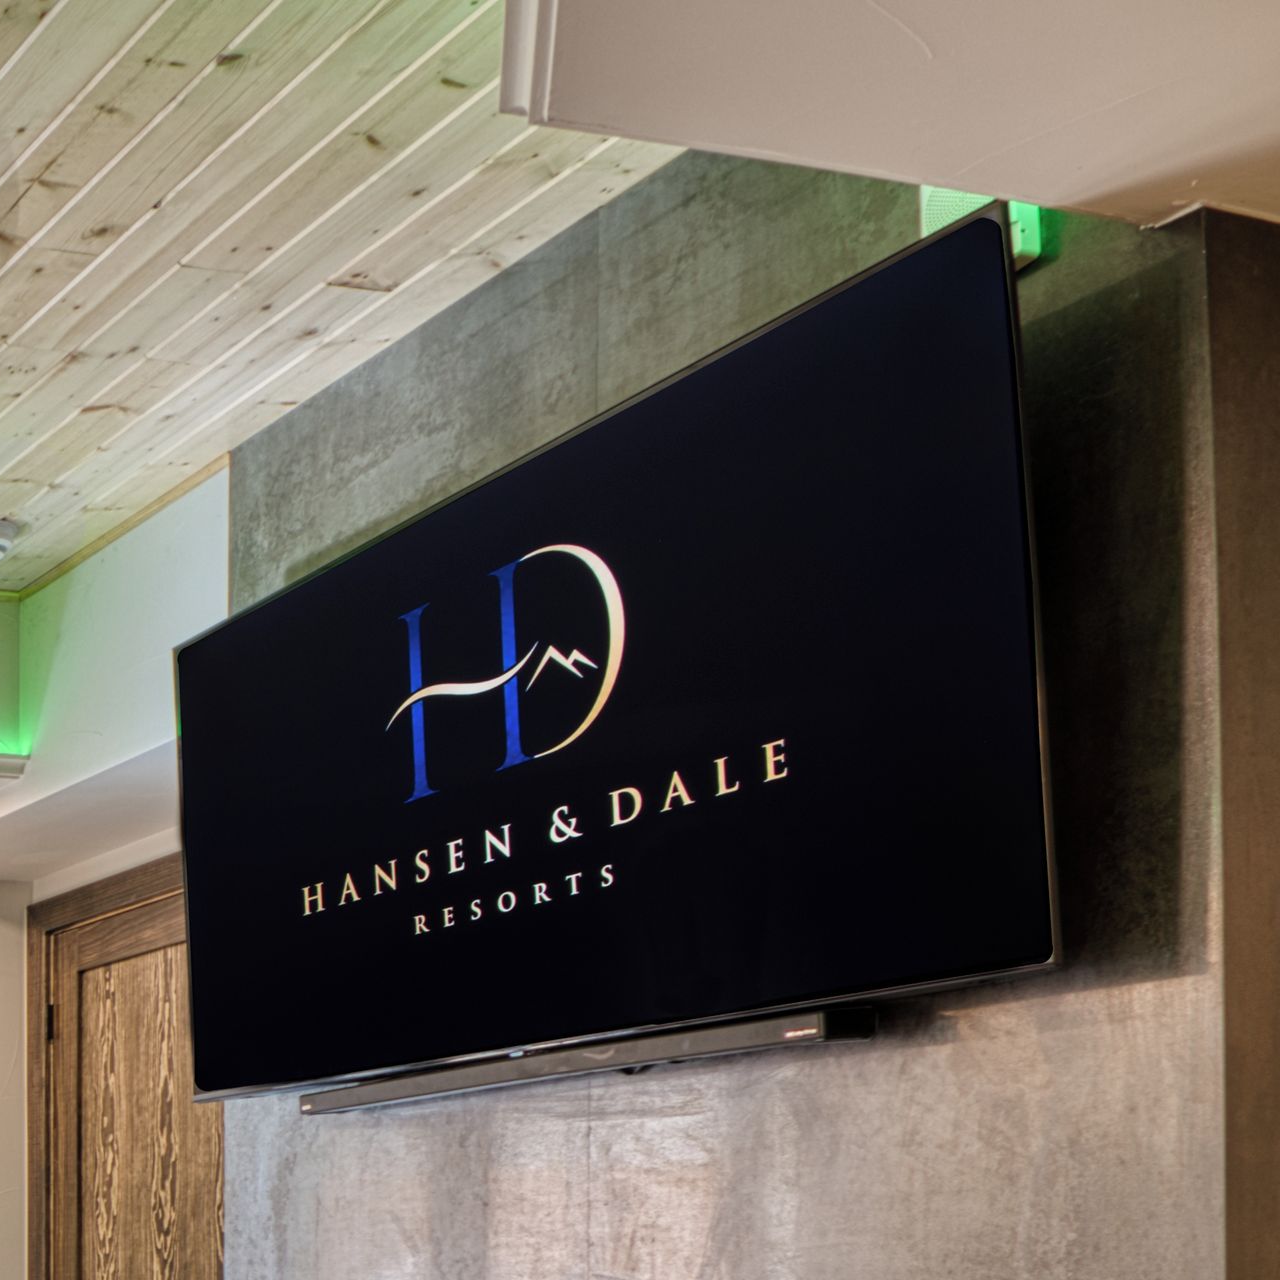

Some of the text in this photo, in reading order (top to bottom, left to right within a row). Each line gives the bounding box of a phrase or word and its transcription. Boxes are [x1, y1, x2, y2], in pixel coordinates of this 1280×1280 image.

[301, 738, 789, 917] HANSEN & DALE
[413, 863, 616, 935] RESORTS
